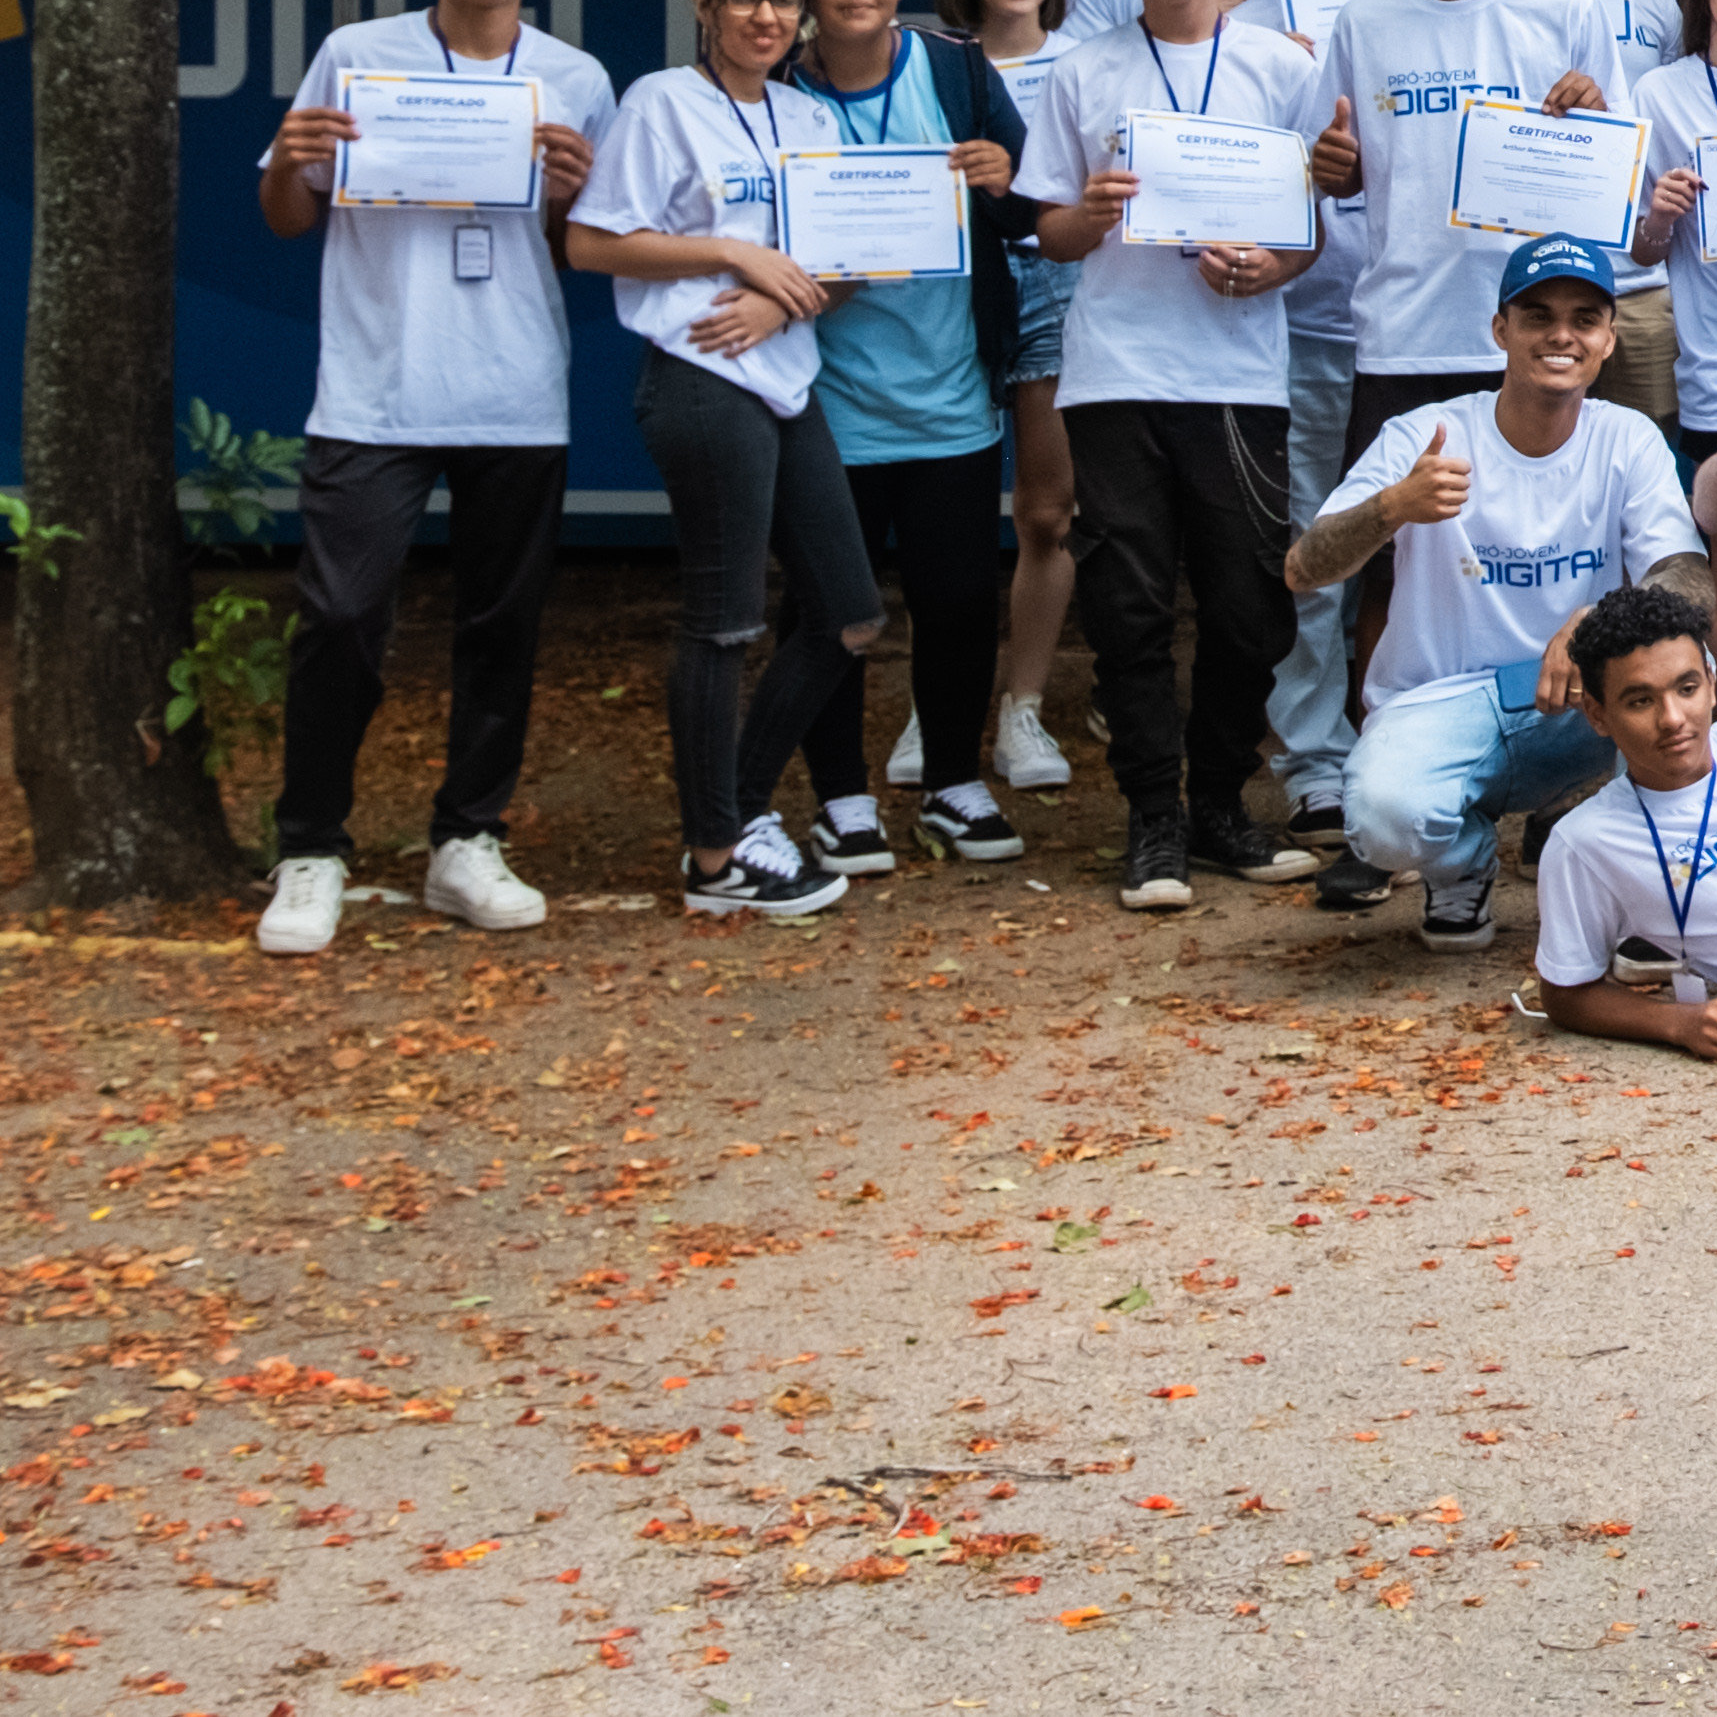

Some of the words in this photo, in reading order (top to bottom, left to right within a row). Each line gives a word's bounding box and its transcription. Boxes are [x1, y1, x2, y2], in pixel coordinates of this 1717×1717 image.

[1388, 69, 1477, 86] PRÓ-JOVEM
[396, 95, 486, 107] CERTIFICADO
[1177, 134, 1260, 150] CERTIFICADO
[1508, 125, 1593, 145] CERTIFICADO
[829, 170, 911, 180] CERTIFICADO
